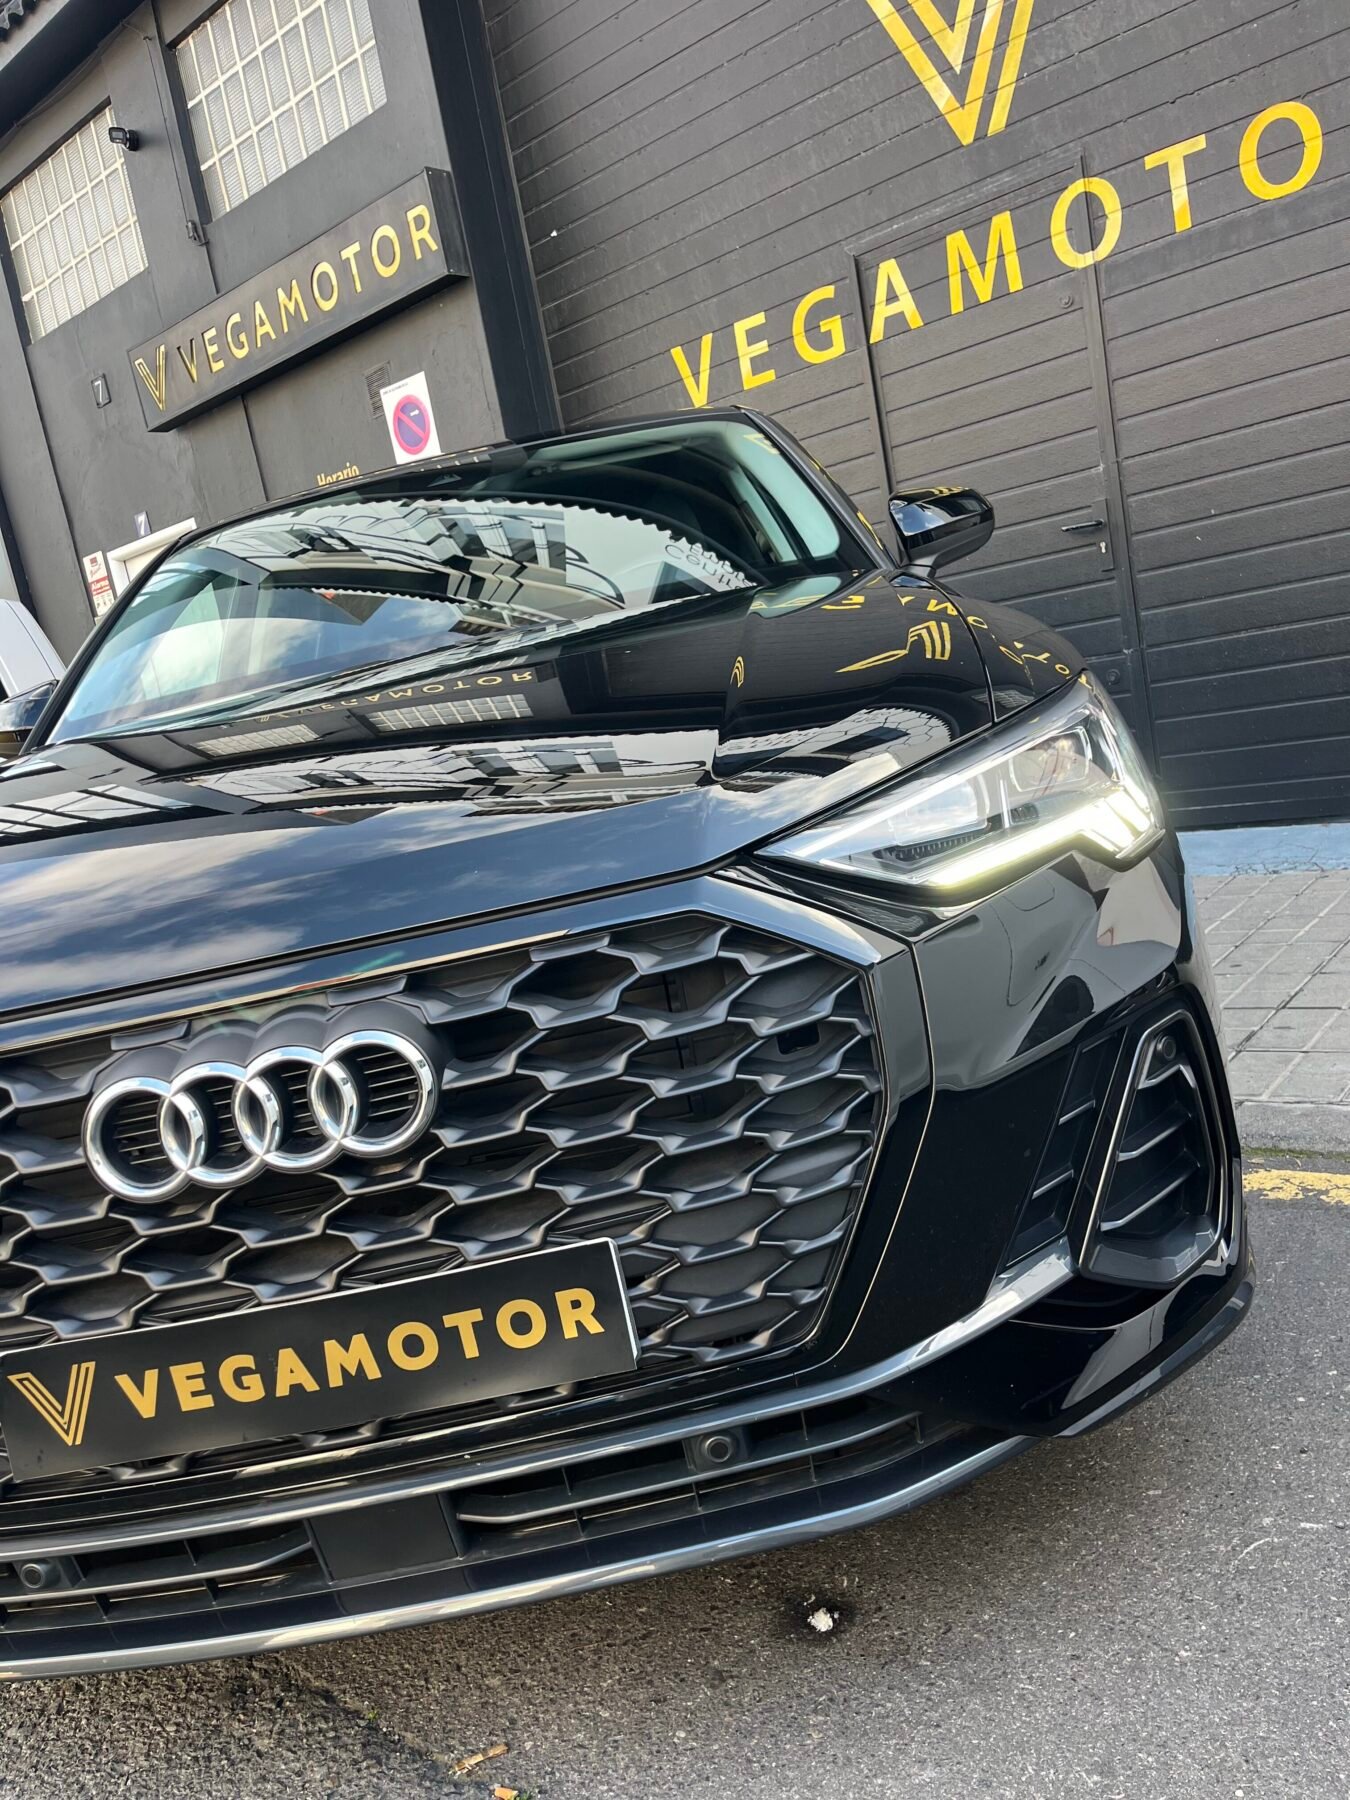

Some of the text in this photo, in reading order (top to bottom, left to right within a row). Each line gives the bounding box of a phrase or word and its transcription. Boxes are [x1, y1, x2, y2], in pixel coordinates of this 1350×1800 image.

[176, 204, 439, 383] VEGAMOTOR
[136, 513, 147, 536] 7
[114, 1287, 605, 1419] VEGAMOTOR
